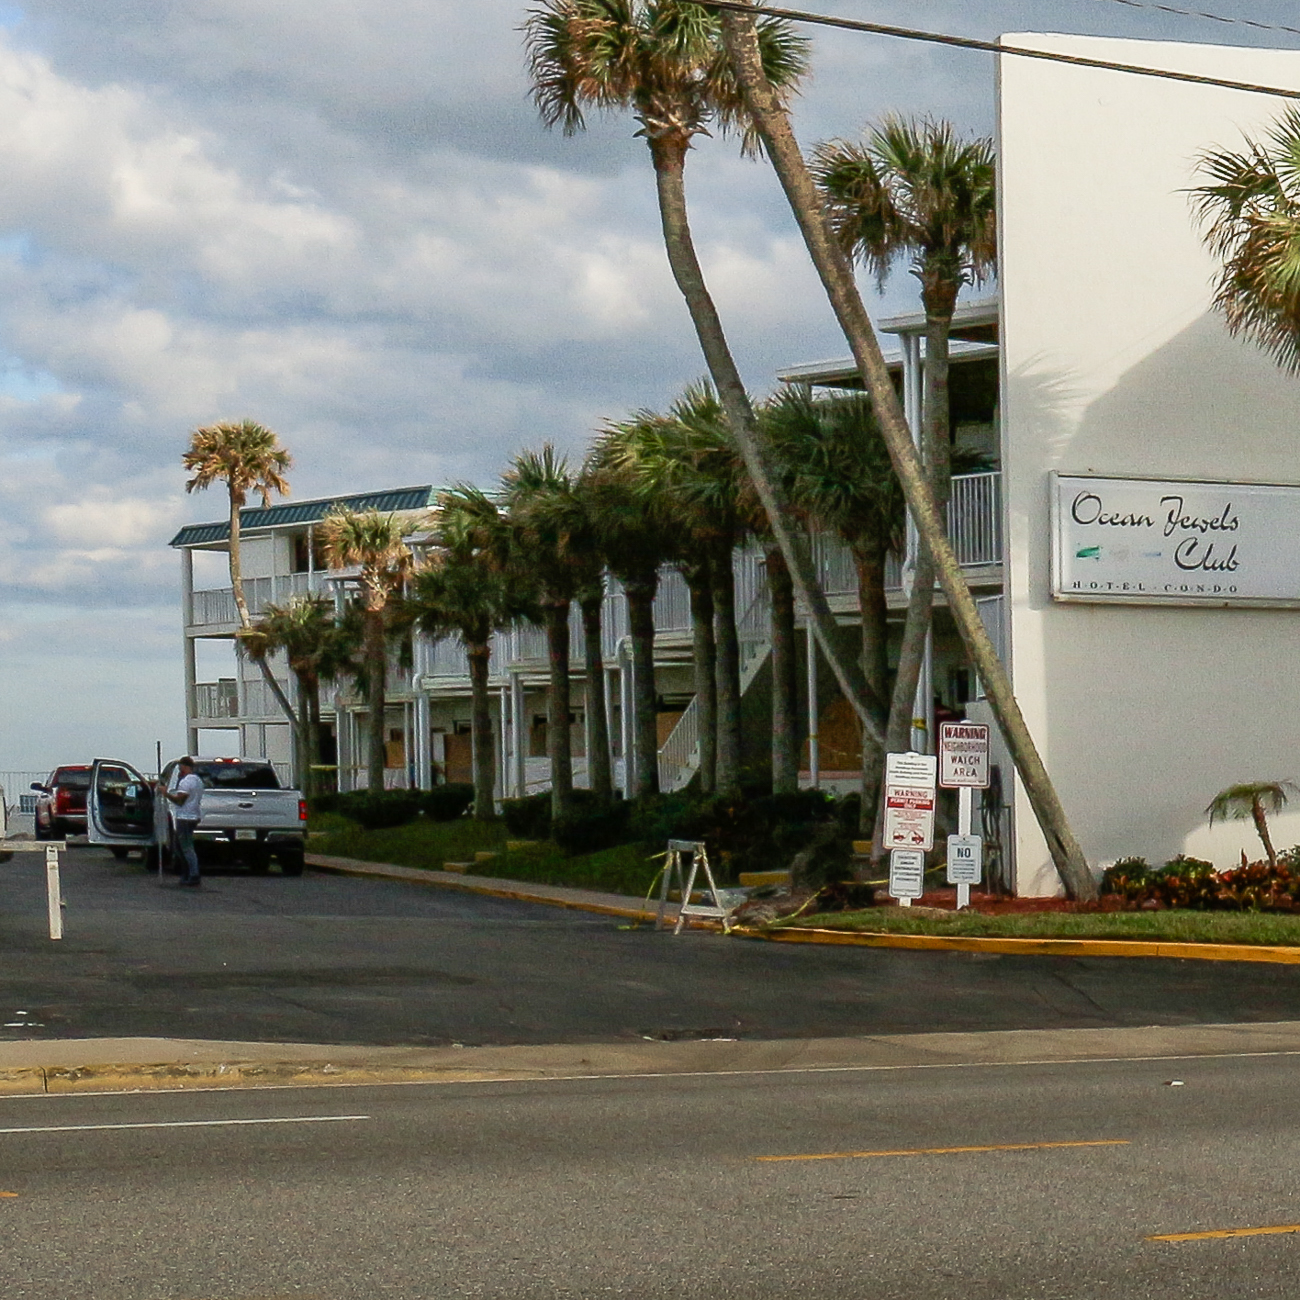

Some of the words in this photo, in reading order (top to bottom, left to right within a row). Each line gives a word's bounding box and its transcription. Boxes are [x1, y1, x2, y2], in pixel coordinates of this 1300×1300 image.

[1071, 490, 1155, 527] Ocean
[1160, 495, 1239, 537] Jewels
[1174, 536, 1240, 572] Club
[944, 726, 987, 739] WARNING
[950, 755, 981, 766] WATCH
[953, 767, 978, 777] AREA
[894, 789, 929, 799] WARNING
[957, 847, 971, 858] NO
